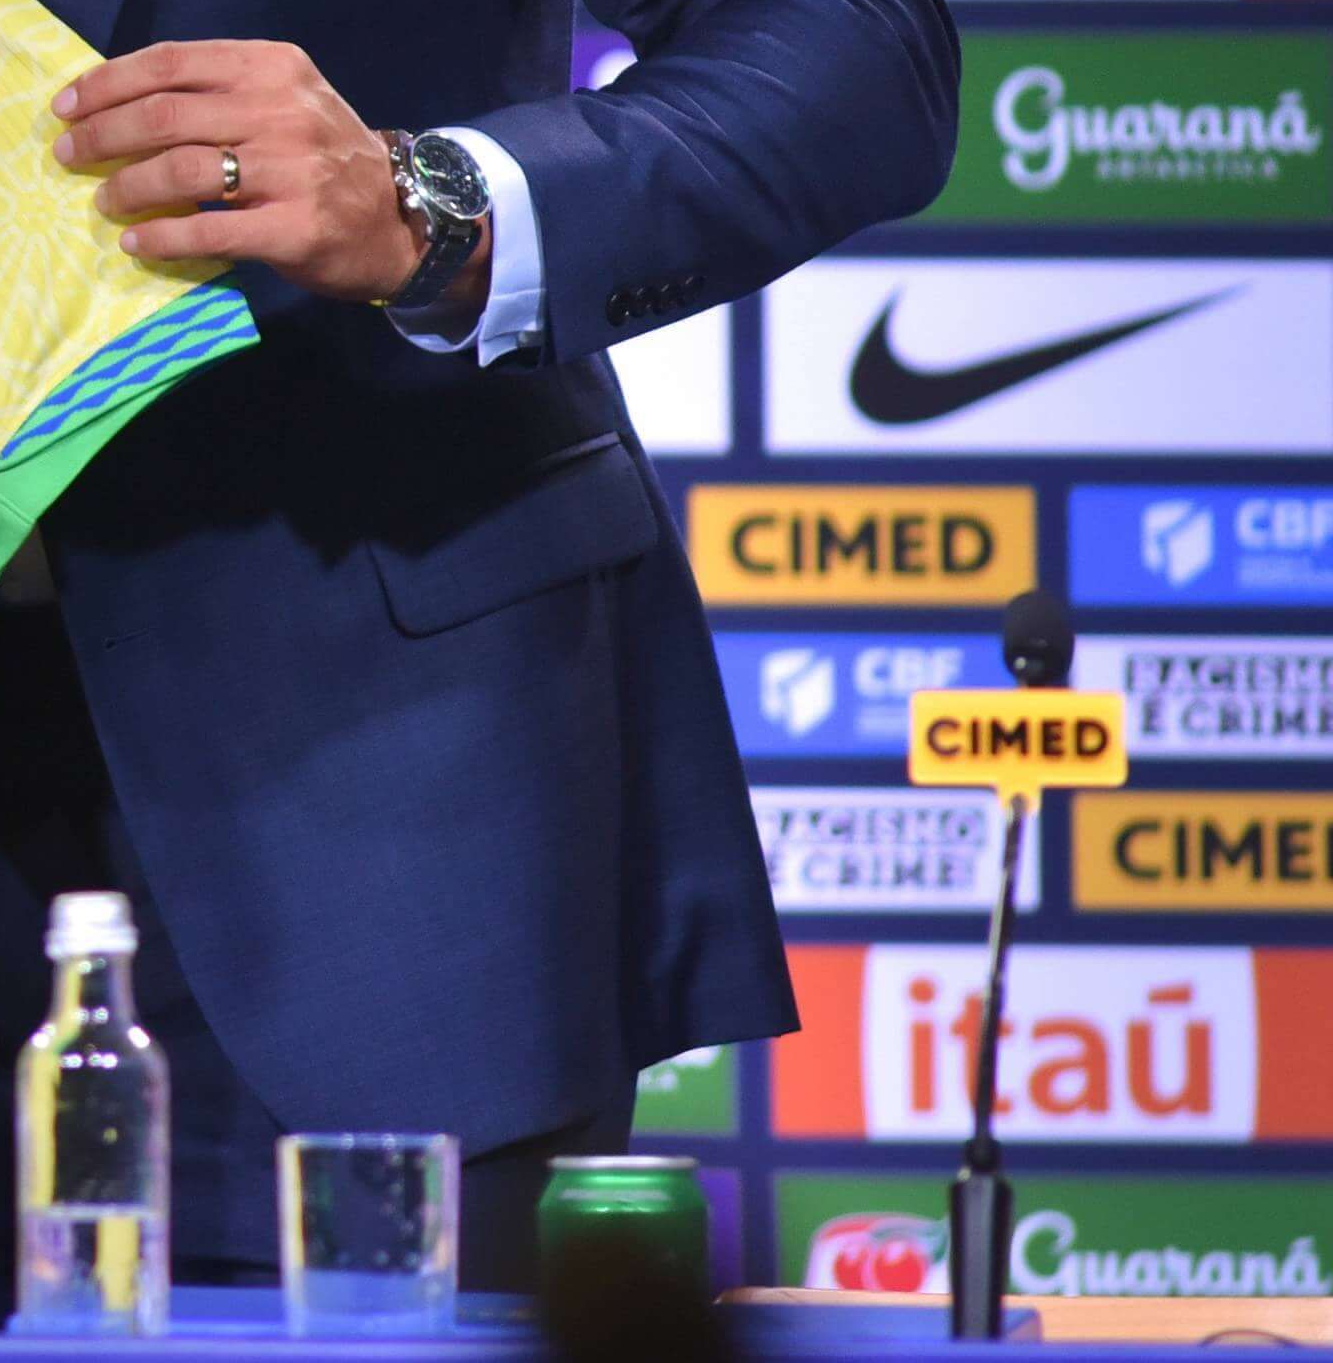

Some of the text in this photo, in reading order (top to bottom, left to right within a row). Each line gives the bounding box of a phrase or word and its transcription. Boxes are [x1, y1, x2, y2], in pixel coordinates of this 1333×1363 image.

[991, 65, 1320, 191] Guaraná
[730, 513, 997, 578] CIMED
[925, 717, 1111, 762] CIMED
[1112, 819, 1333, 884] CIME
[908, 978, 1213, 1116] itaú
